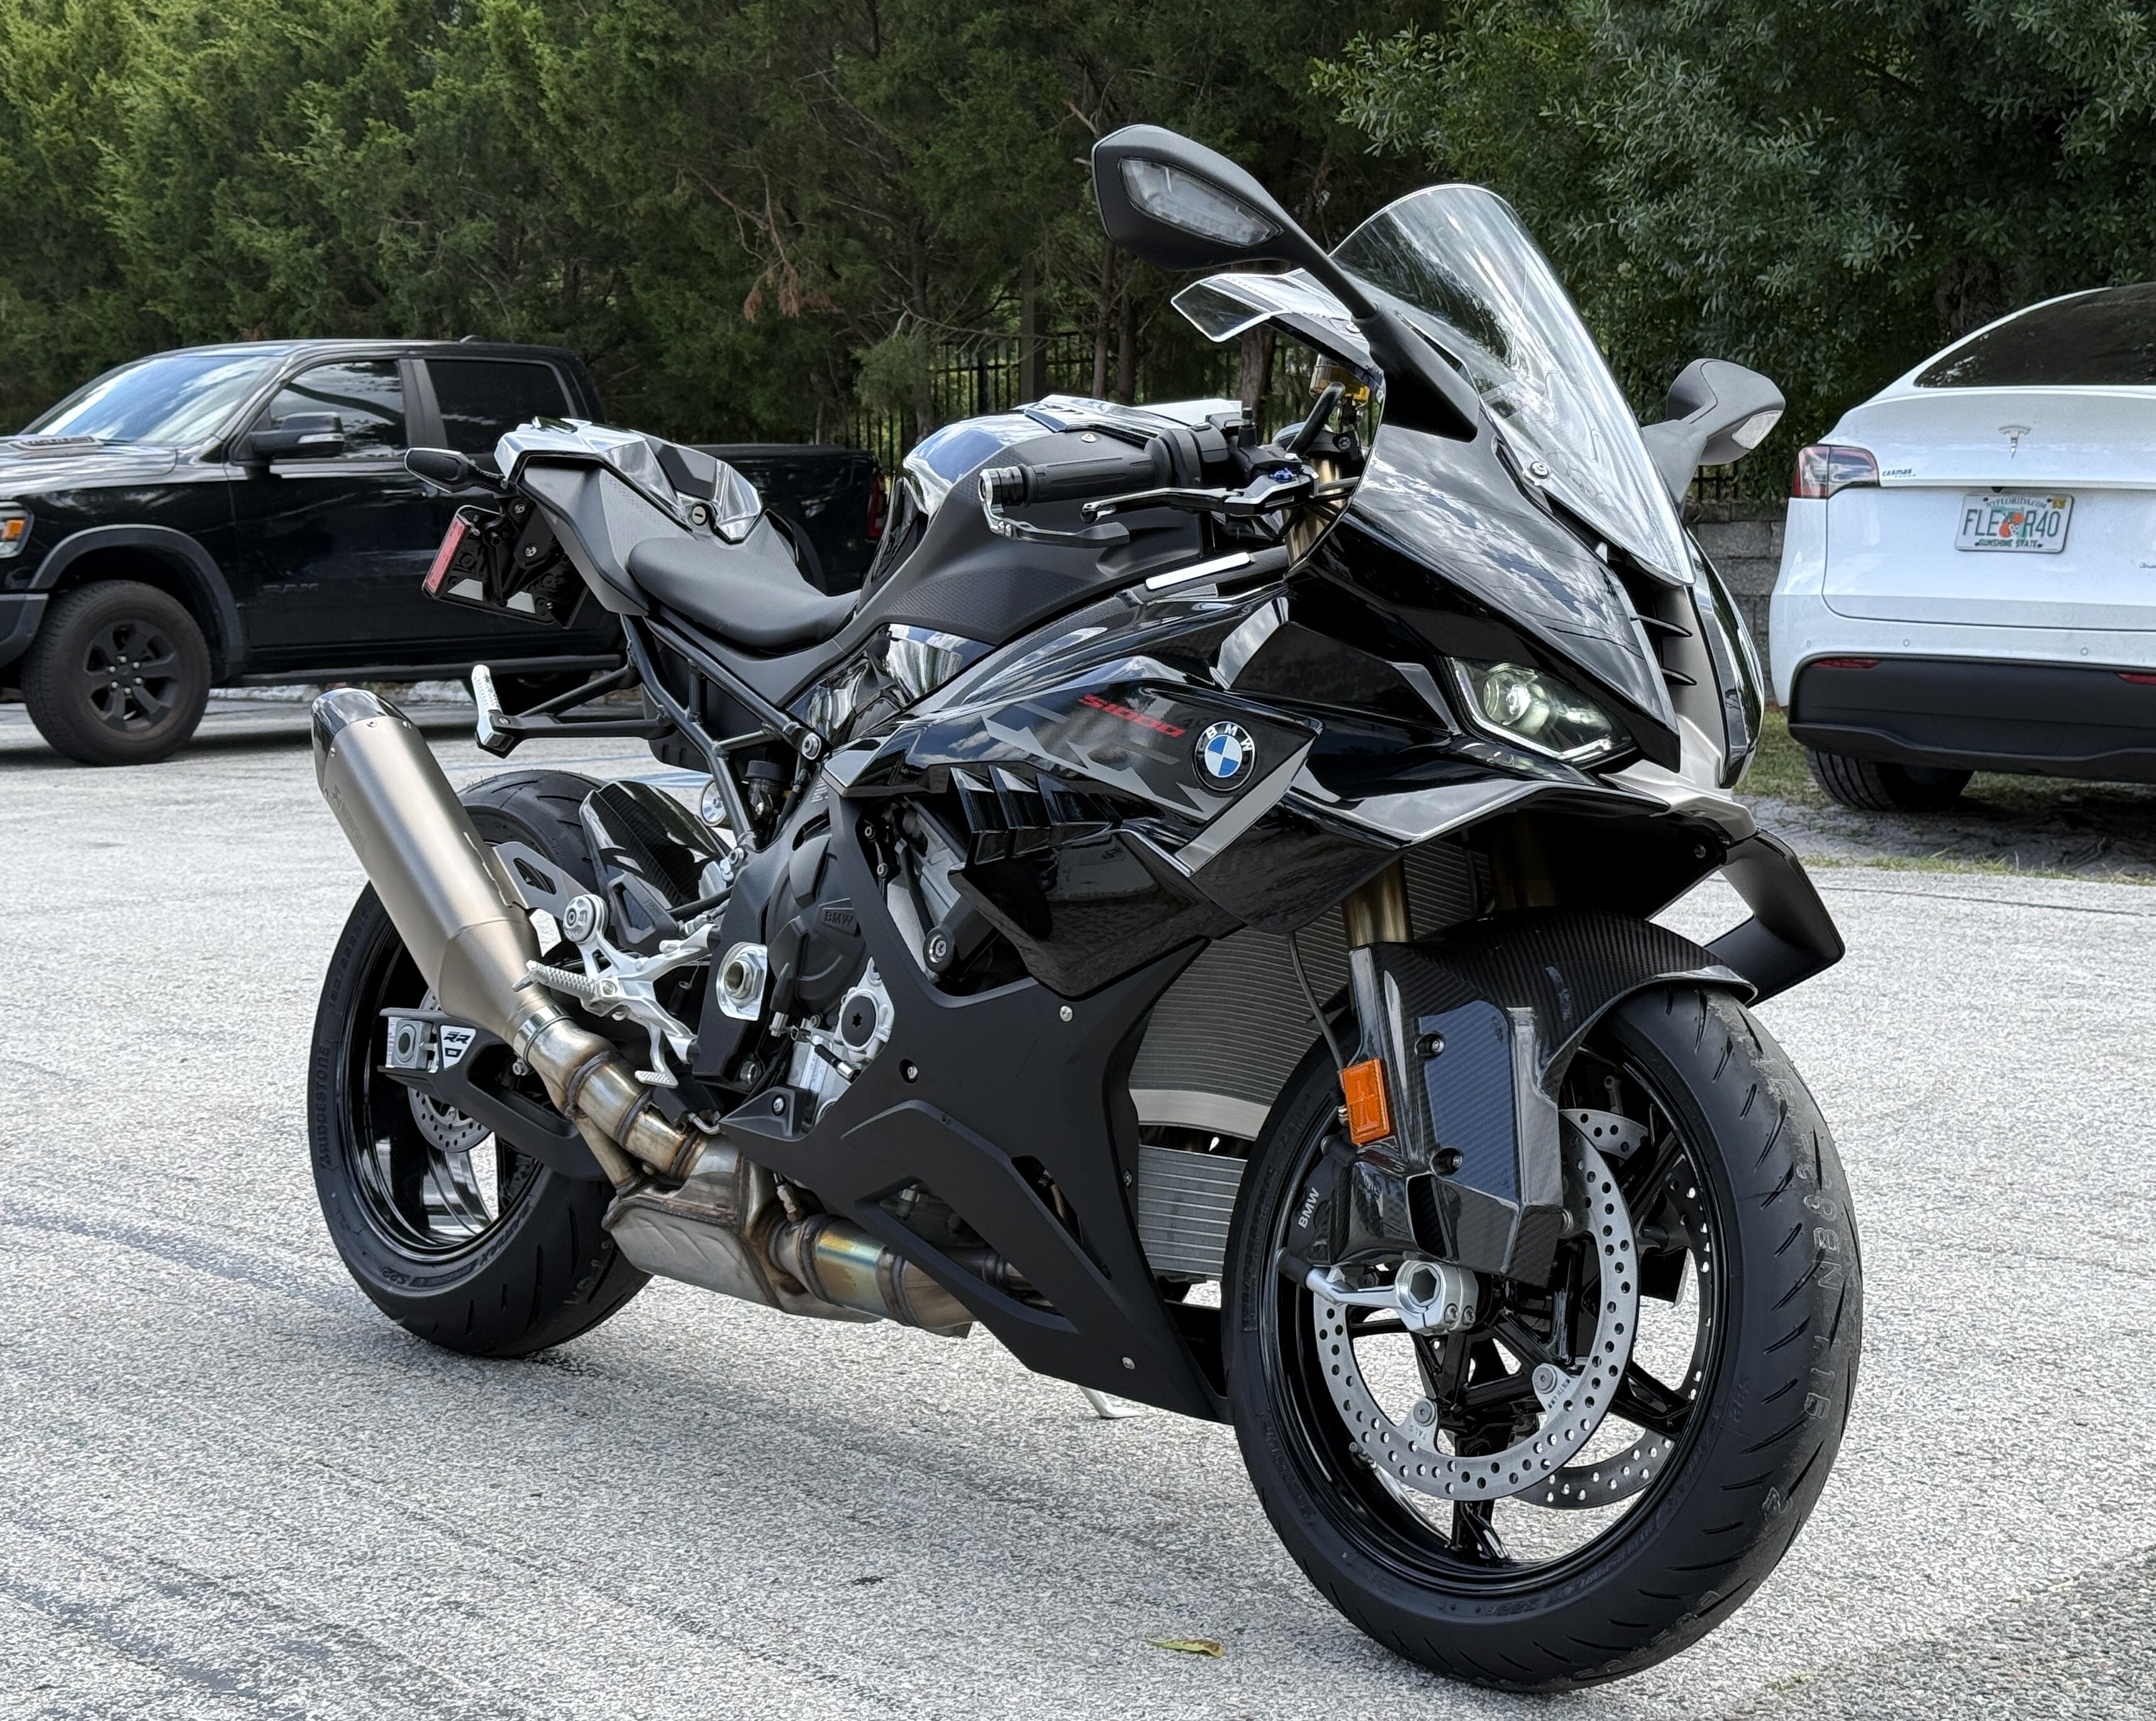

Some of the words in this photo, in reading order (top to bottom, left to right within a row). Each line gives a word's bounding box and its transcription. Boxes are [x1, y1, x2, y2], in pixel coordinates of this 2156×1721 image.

[2015, 539, 2038, 548] STATE
[1206, 723, 1253, 752] BMW
[823, 911, 854, 926] BMW
[443, 1033, 471, 1044] RR
[316, 1044, 331, 1169] BRIDGESTONE
[1297, 1186, 1320, 1230] BMW
